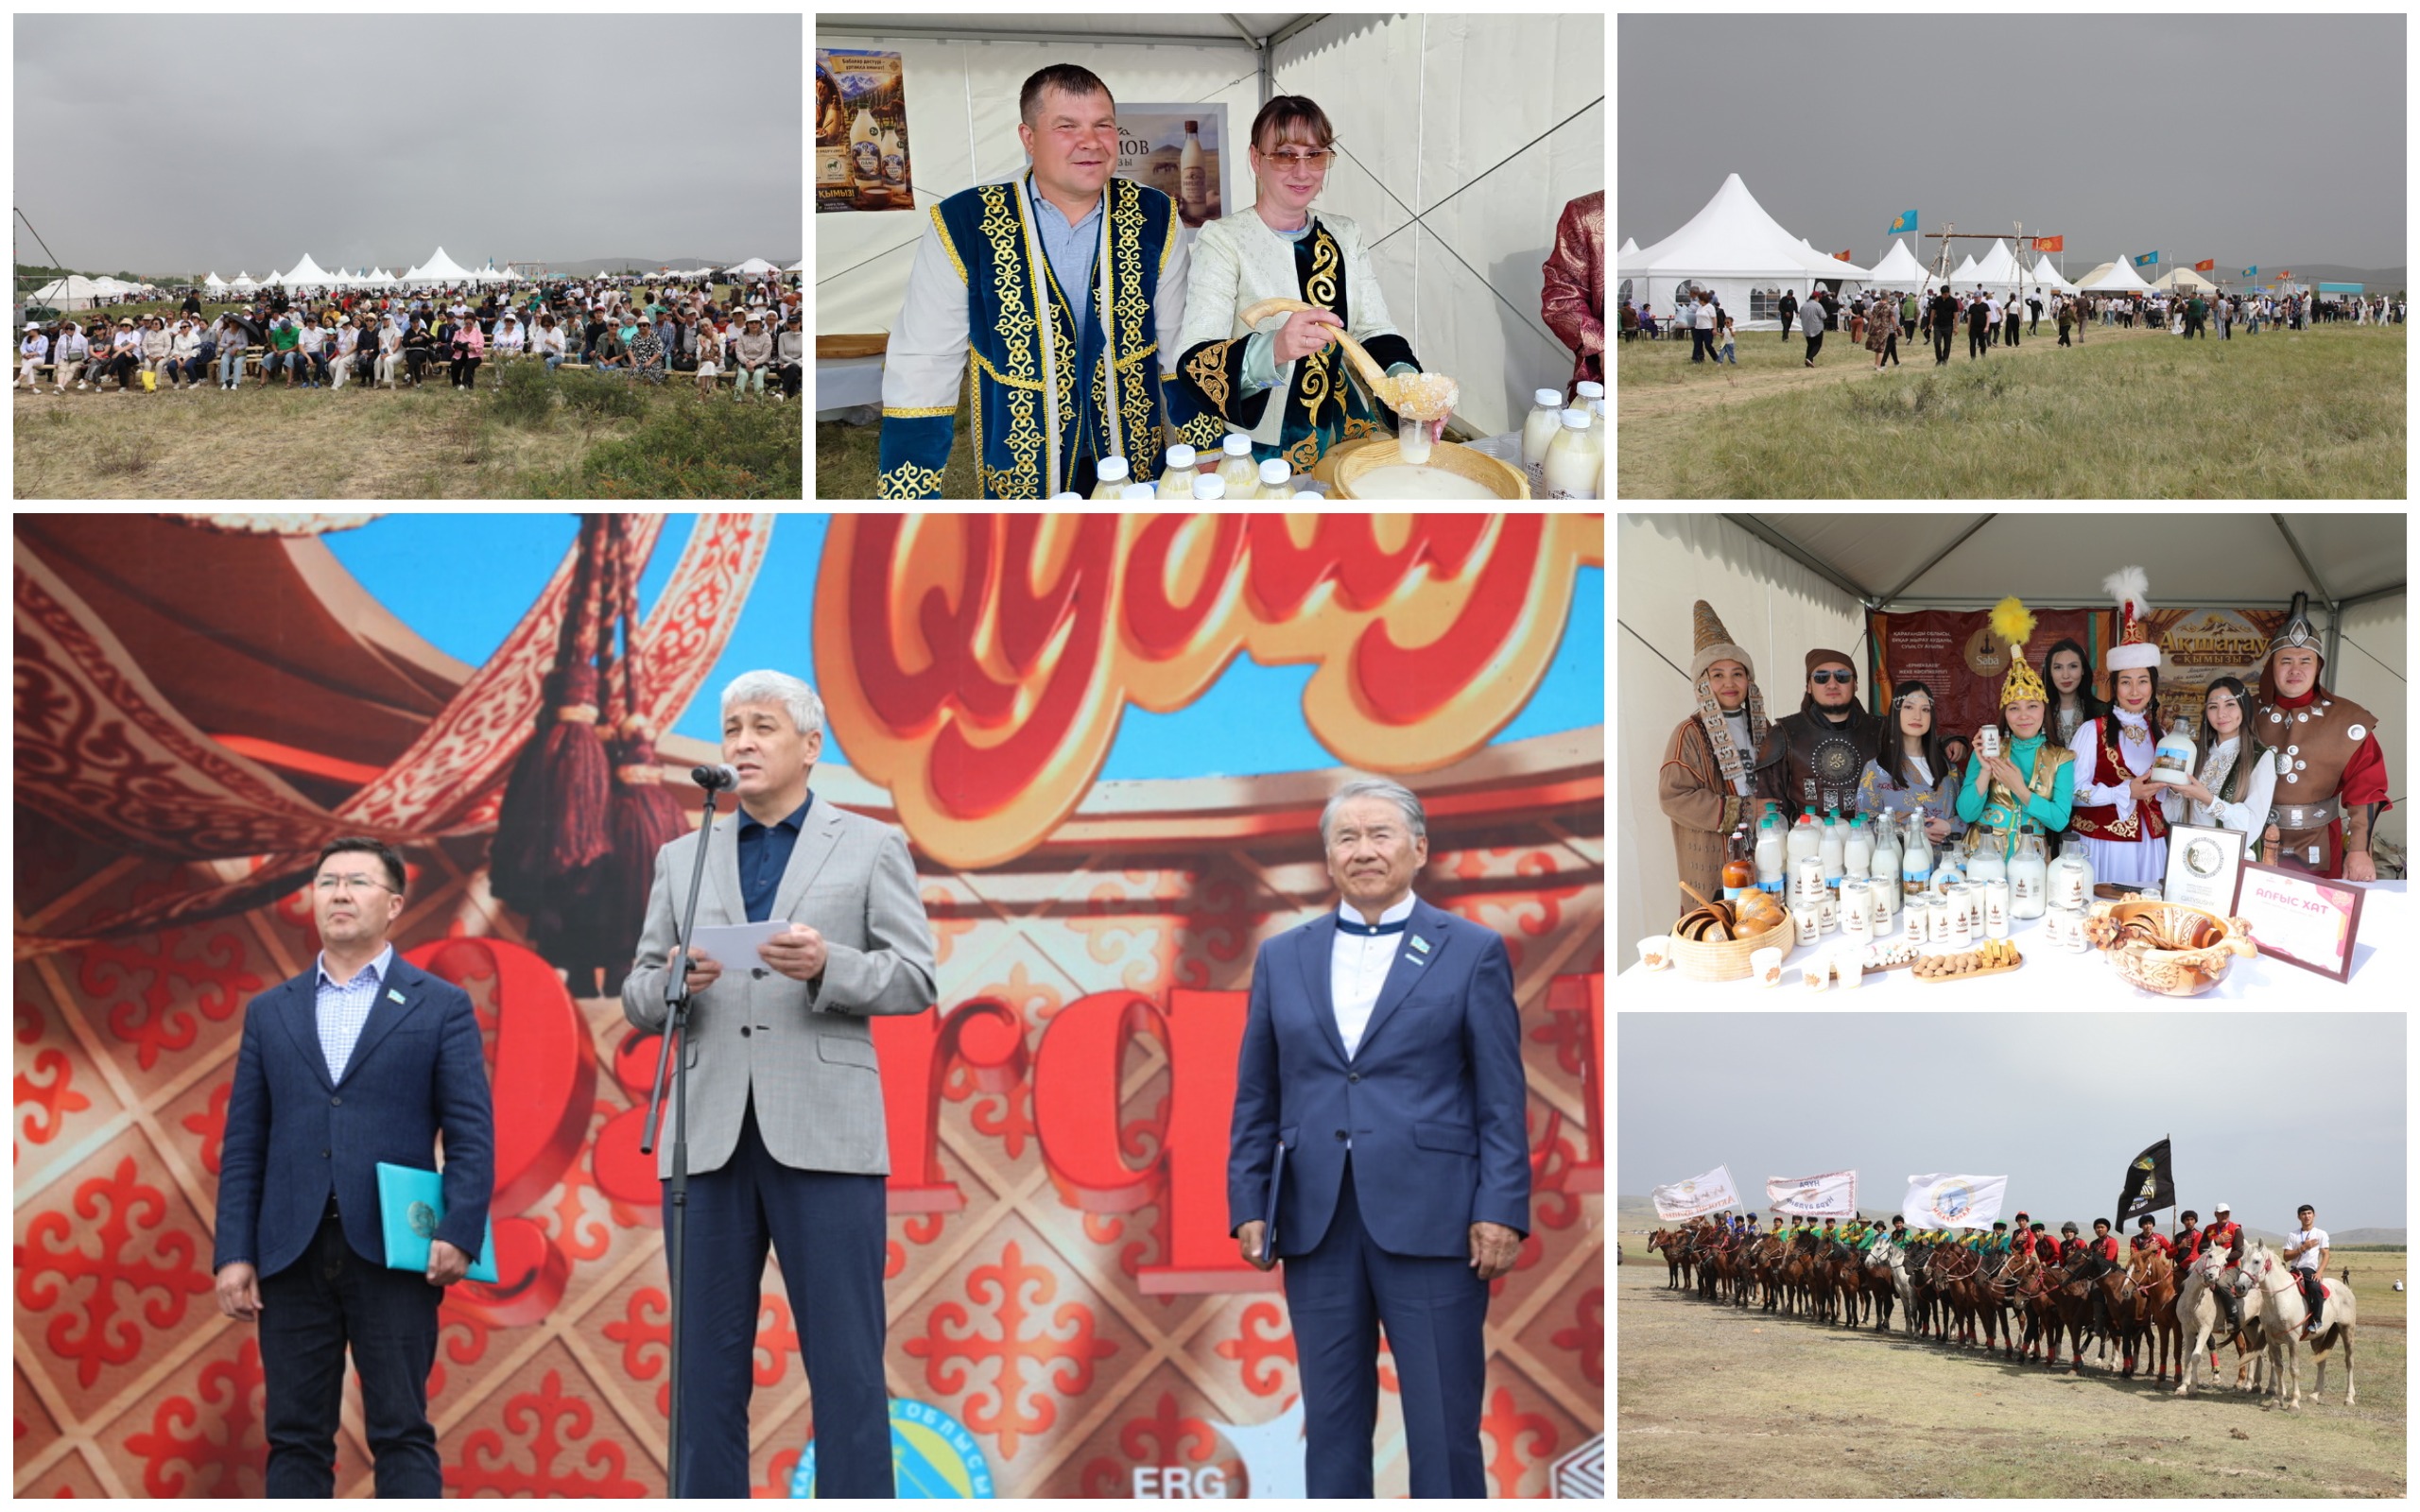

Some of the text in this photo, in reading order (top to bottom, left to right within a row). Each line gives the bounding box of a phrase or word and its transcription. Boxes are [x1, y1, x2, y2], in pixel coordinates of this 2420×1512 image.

[2159, 630, 2271, 660] Ақшатау
[2185, 656, 2241, 664] ҚЫМЫЗЫ
[2256, 887, 2300, 907] АЛҒЫС
[2303, 900, 2329, 915] ХАТ
[906, 1402, 990, 1495] ОБЛЫСЫ
[1132, 1466, 1227, 1499] ERG
